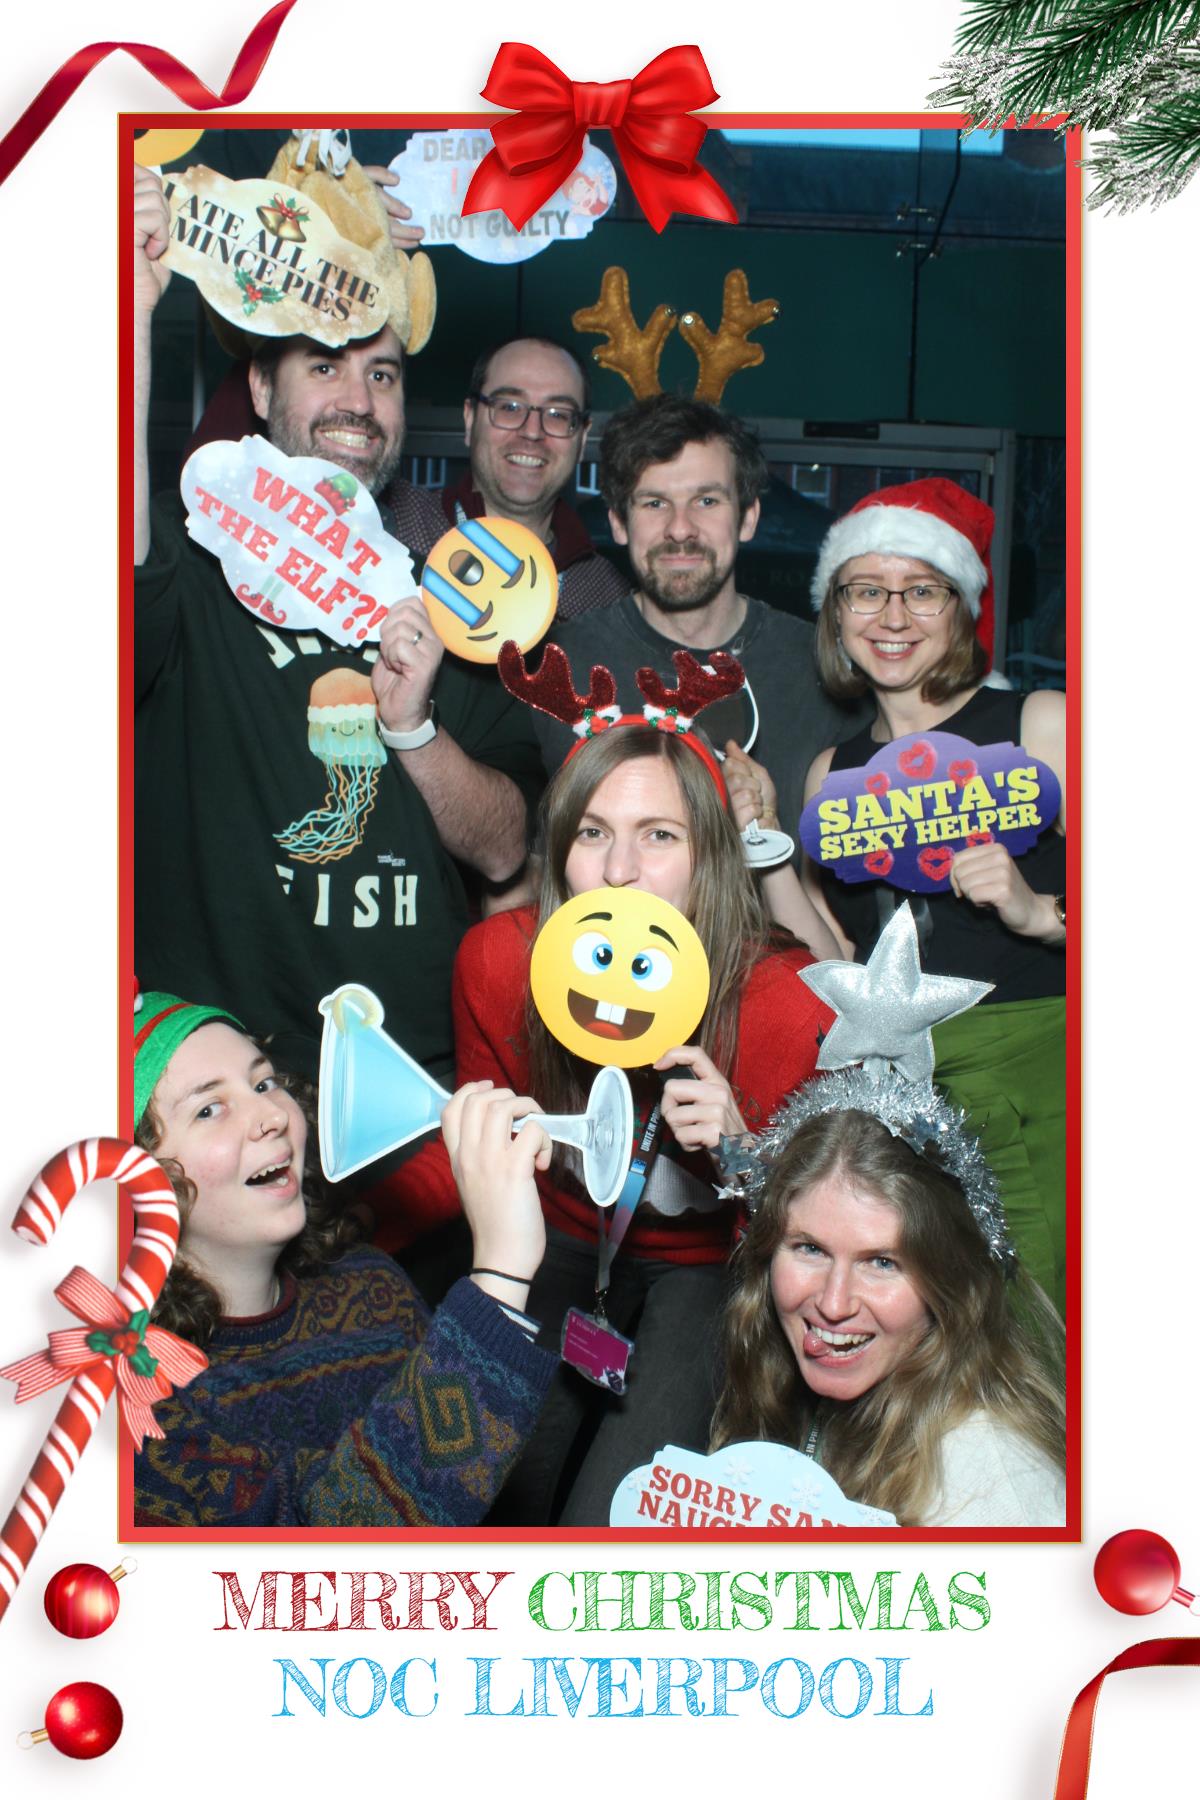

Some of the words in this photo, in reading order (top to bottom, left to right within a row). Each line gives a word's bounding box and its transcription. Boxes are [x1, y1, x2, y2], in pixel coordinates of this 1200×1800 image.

[424, 137, 488, 162] DEAR
[177, 194, 244, 240] ATE
[246, 229, 306, 273] ALL
[316, 258, 380, 308] THE
[430, 212, 479, 239] NOT
[170, 216, 279, 286] MINCE
[281, 270, 352, 322] PIES
[252, 466, 382, 576] WHAT
[195, 486, 279, 562] THE
[275, 546, 389, 640] ELF?!
[817, 766, 1041, 835] SANTA'S
[819, 823, 908, 861] SEXY
[915, 803, 1042, 845] HELPER
[640, 1130, 655, 1152] UNITE
[647, 1121, 657, 1133] IN
[649, 1465, 762, 1522] SORRY
